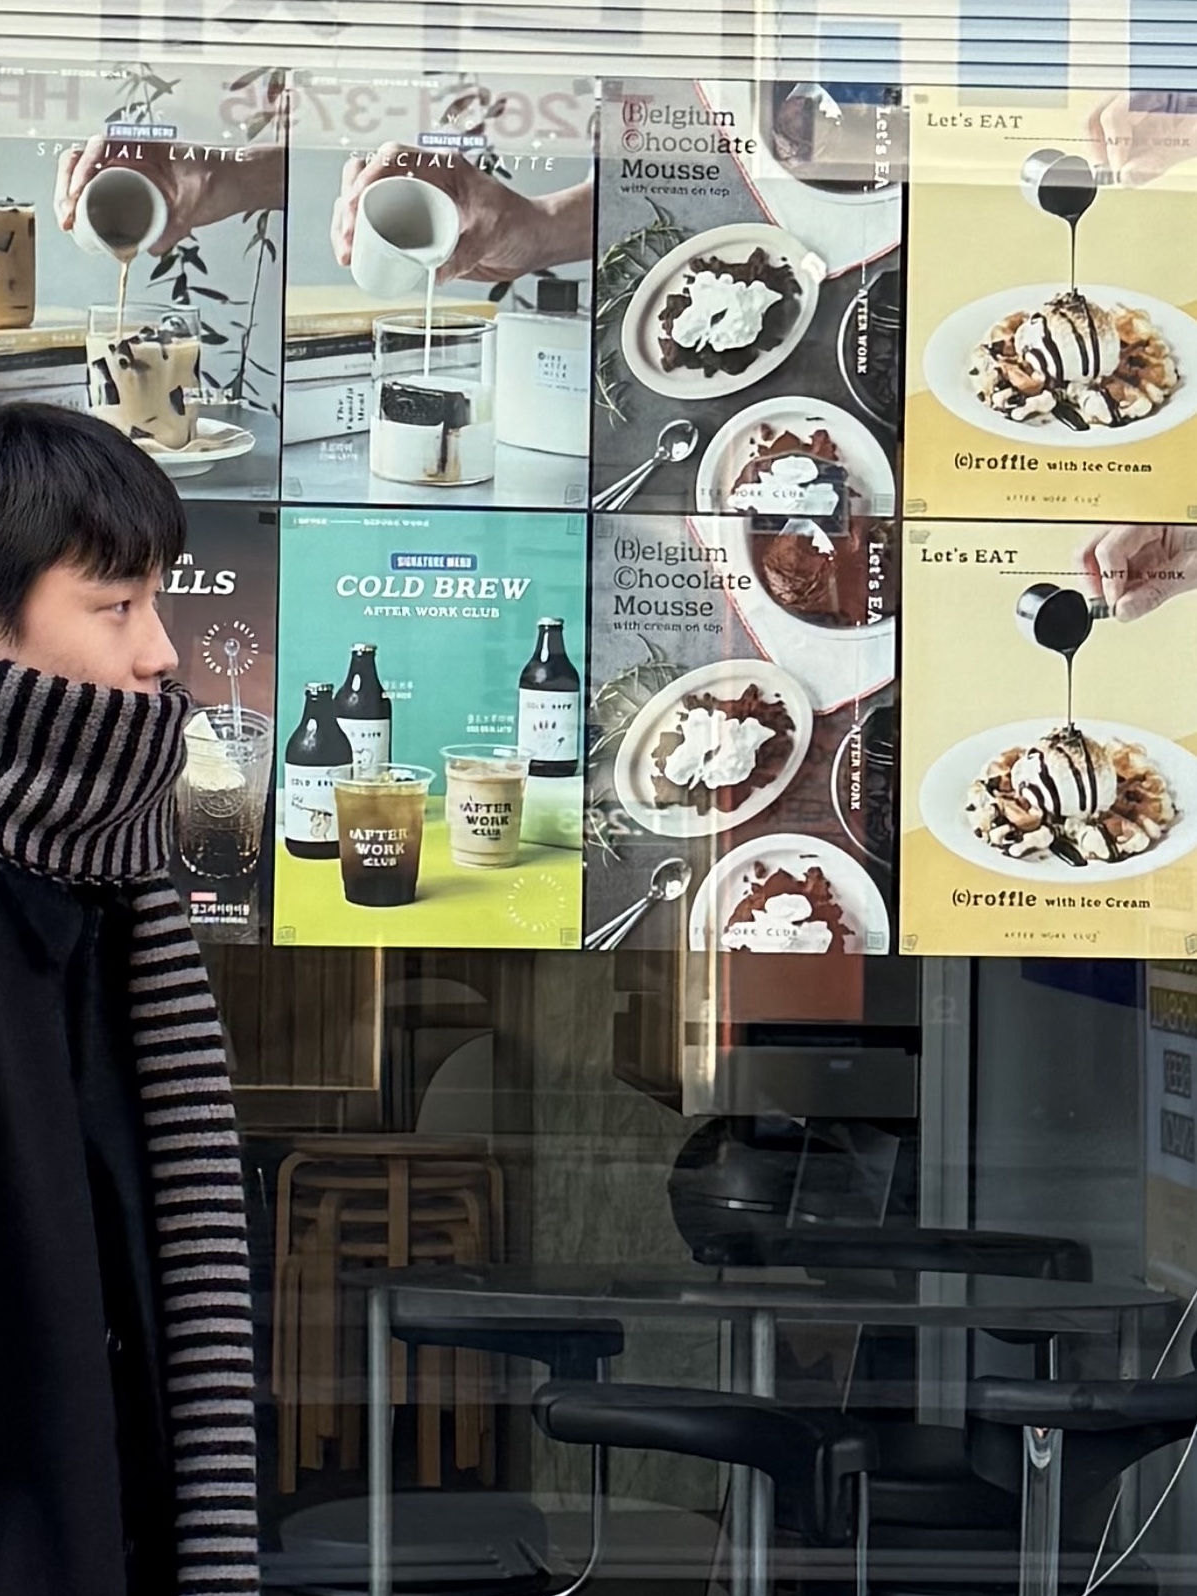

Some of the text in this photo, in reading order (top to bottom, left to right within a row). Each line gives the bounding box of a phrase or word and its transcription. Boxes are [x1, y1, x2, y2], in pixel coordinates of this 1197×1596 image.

[927, 112, 1023, 129] Let's EAT
[875, 106, 892, 155] Let's
[37, 142, 245, 162] SPEIAL LATTE
[479, 156, 555, 172] LATTE
[621, 159, 720, 181] Mousse
[620, 183, 647, 195] with
[856, 333, 868, 374] WORK
[1047, 461, 1078, 472] with
[1082, 461, 1103, 472] Ice
[1107, 461, 1152, 473] Cream
[614, 536, 729, 566] (B)elgium
[921, 547, 1018, 564] Let's EAT
[868, 542, 885, 590] Let's
[336, 575, 532, 600] COLD BREW
[363, 605, 501, 618] AFTER WORK CLUB
[613, 595, 714, 617] Mousse
[613, 620, 641, 630] with
[850, 772, 862, 810] WORK
[465, 815, 510, 826] WORK
[350, 827, 409, 841] AFTER
[355, 842, 406, 855] WORK
[1045, 897, 1076, 908] with
[1080, 897, 1101, 908] Ice
[1105, 897, 1151, 908] Cream
